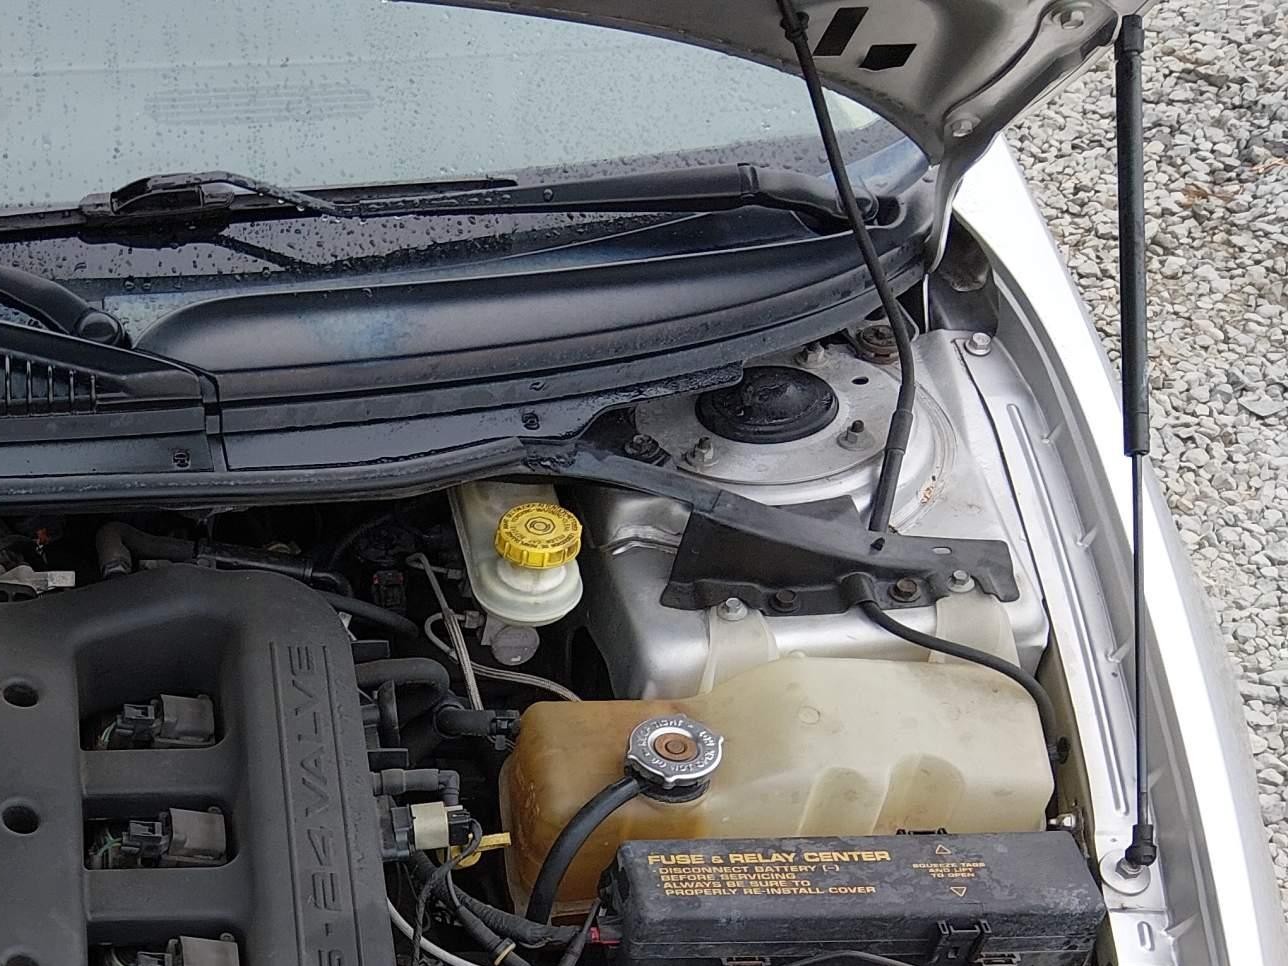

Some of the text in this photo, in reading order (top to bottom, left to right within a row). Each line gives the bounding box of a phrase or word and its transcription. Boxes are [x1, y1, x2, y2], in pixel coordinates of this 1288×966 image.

[288, 644, 333, 818] VALVE
[648, 851, 891, 865] FUSE & RELAY CENTER
[659, 866, 748, 874] DISCONNECT
[754, 865, 816, 873] BATTERY
[720, 873, 796, 881] SERVICING
[666, 888, 737, 896] PROPERLY
[828, 886, 877, 894] COVER
